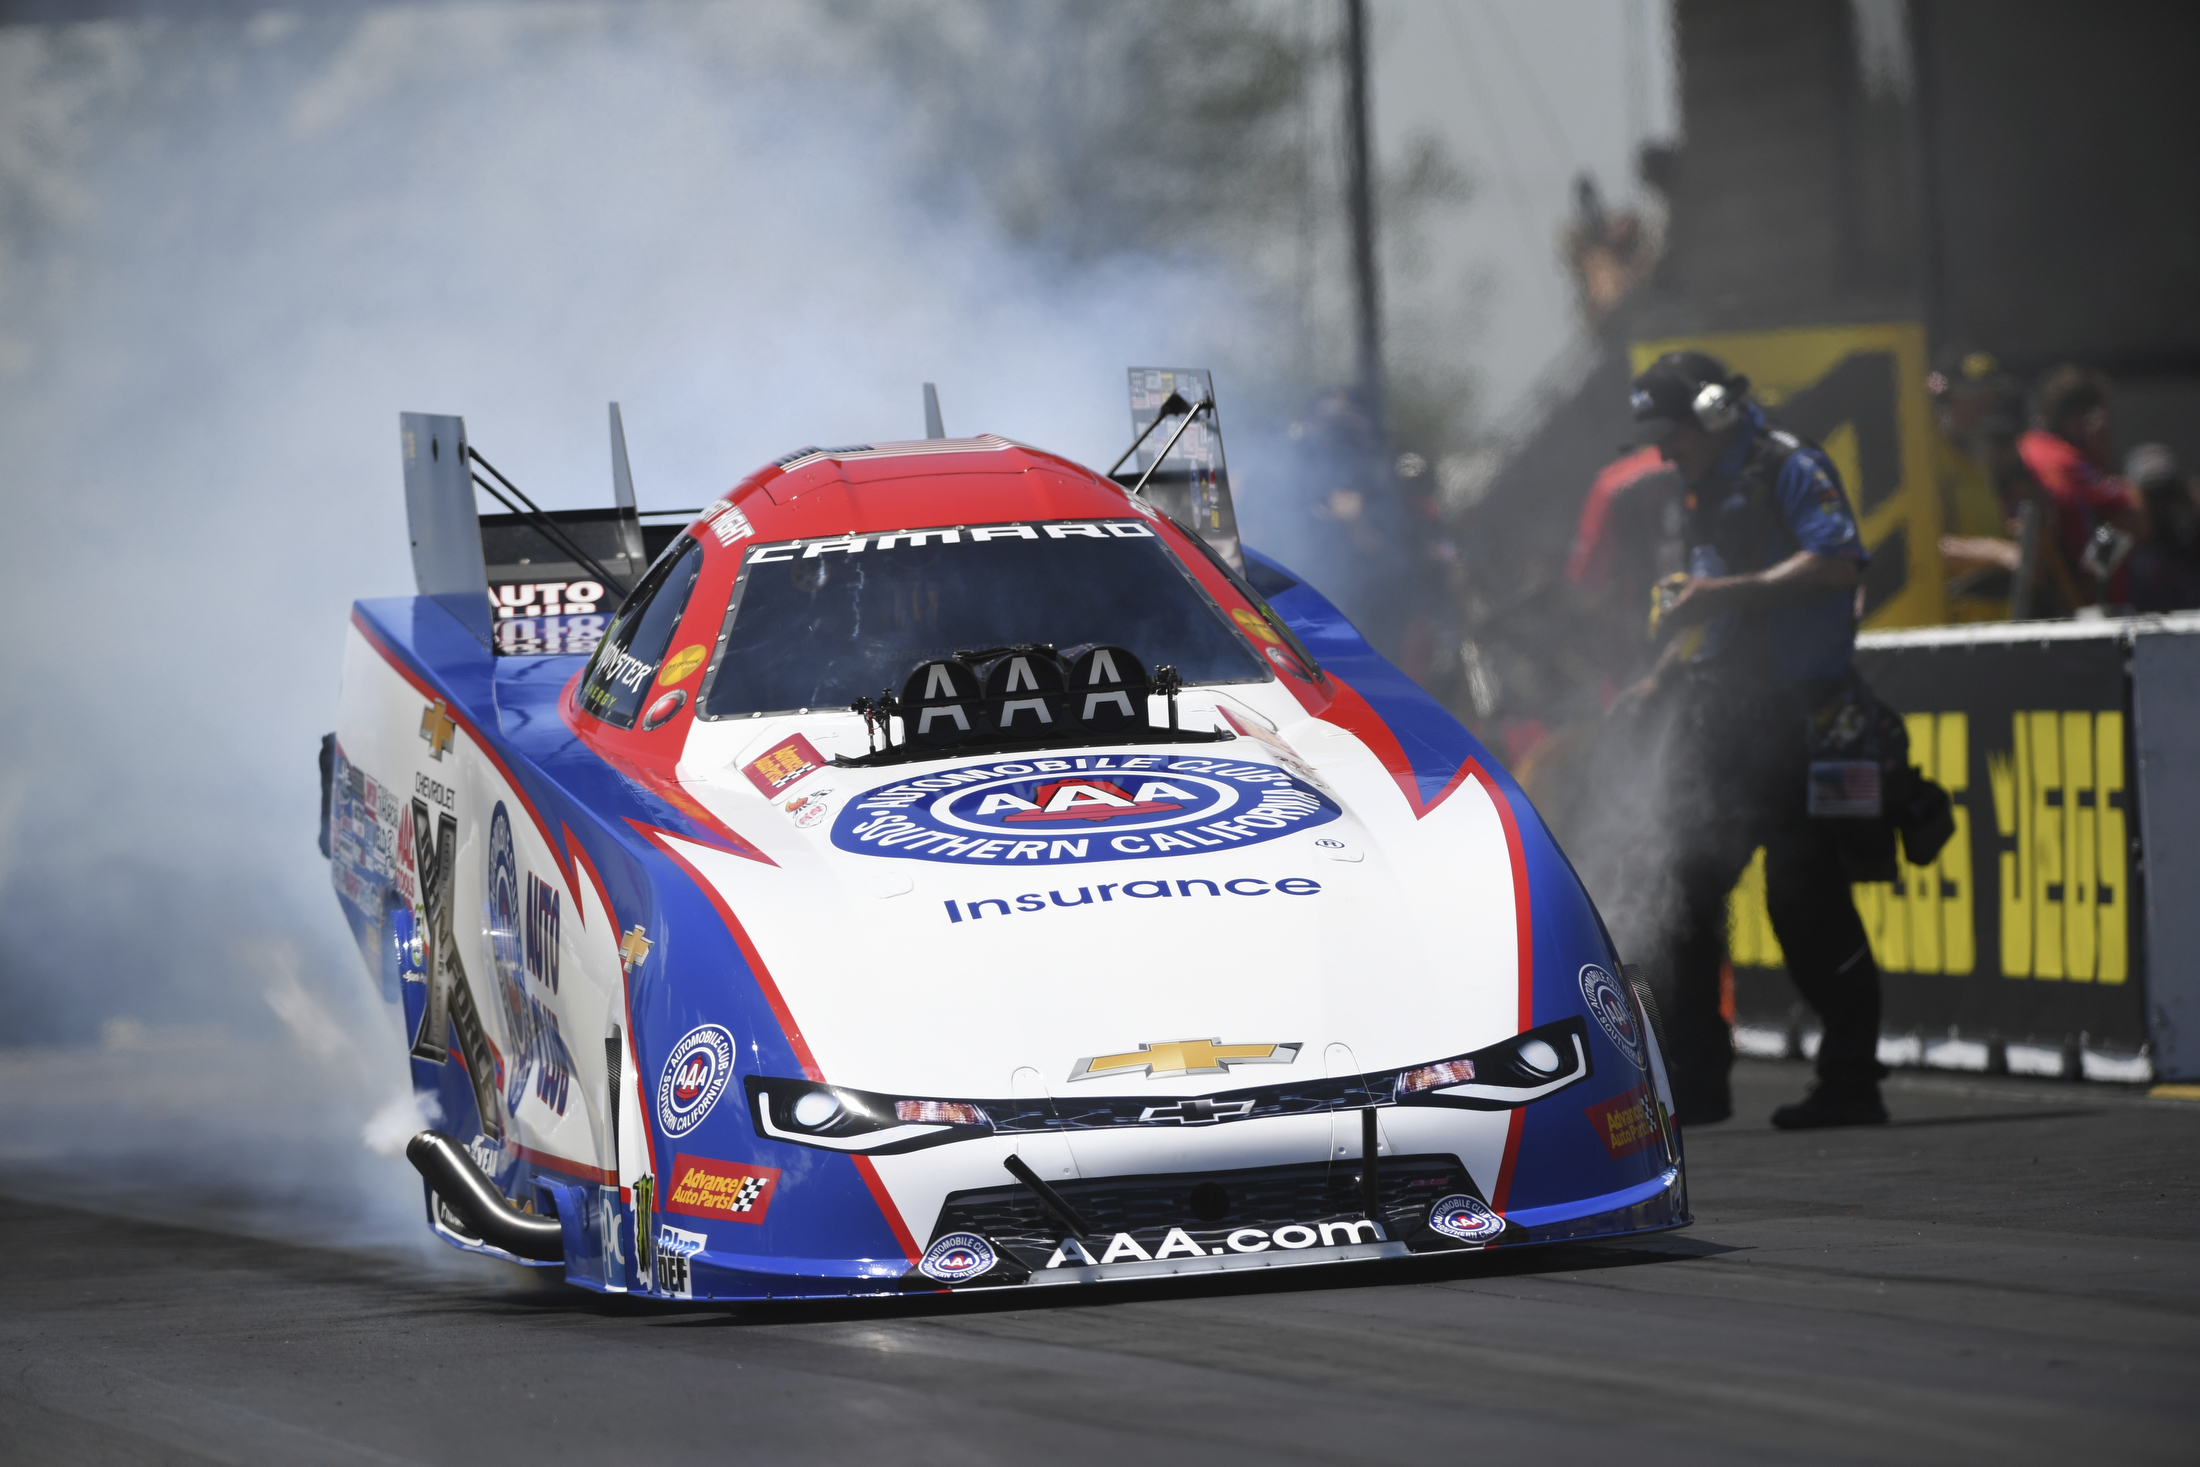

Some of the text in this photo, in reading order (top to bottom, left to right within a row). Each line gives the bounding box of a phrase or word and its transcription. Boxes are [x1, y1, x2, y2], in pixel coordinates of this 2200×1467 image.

[747, 523, 1155, 564] CAMARO
[596, 639, 652, 694] MONSTER
[416, 771, 455, 812] CHEVROLET
[857, 757, 1293, 811] AUTOMOBILE CLUB
[975, 781, 1199, 816] AAA
[852, 788, 1323, 860] SOUTHERN CALIFORNIA
[1988, 710, 2129, 985] JEGS
[943, 876, 1323, 924] Insurance
[526, 870, 561, 996] AUTO
[670, 1030, 731, 1071] AUTOMOBILE CLUB
[676, 1063, 709, 1090] AAA
[660, 1075, 724, 1132] SOUTHERN CALIFORNIA
[1606, 1103, 1644, 1132] Advance
[1610, 1129, 1633, 1149] Auto
[671, 1186, 731, 1210] Auto Parts
[679, 1167, 739, 1194] Advance
[1434, 1198, 1492, 1225] AUTOMOBILE CLUB
[1451, 1217, 1483, 1227] AAA
[928, 1236, 991, 1263] AUTOMOBILE CLUB
[941, 1257, 973, 1267] AAA
[1045, 1219, 1387, 1269] AAA.com
[657, 1257, 688, 1293] DEF
